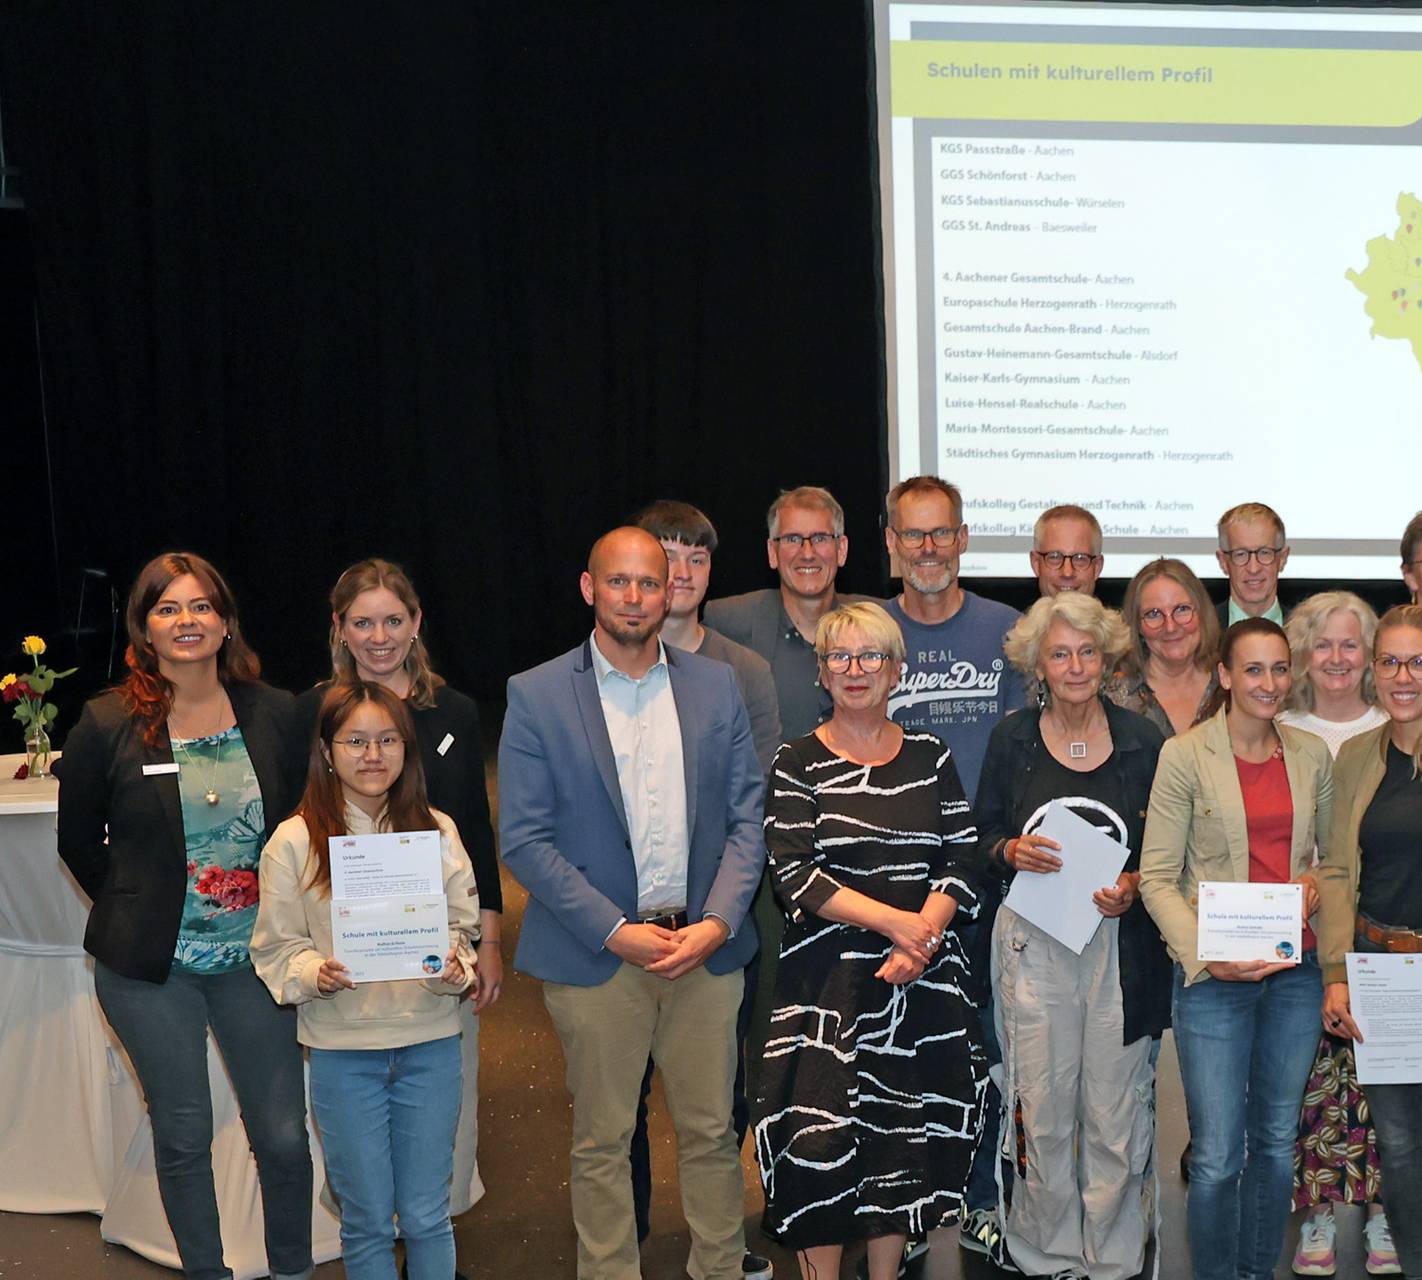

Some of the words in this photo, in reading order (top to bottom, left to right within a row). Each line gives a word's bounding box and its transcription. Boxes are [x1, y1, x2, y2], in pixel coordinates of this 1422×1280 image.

[927, 62, 1002, 80] Schulen
[1008, 63, 1040, 81] mit
[1046, 64, 1155, 82] kulturellem
[1161, 66, 1213, 84] Profil
[940, 144, 963, 155] KGS
[1034, 145, 1074, 157] Aachen
[940, 169, 965, 181] GGS
[966, 169, 1028, 182] Schönforst
[1036, 171, 1076, 183] Aachen
[941, 195, 964, 206] KGS
[1076, 196, 1125, 209] Würselen
[941, 220, 966, 232] GGS
[967, 220, 982, 232] St.
[985, 221, 1031, 233] Andreas
[942, 272, 953, 283] 4.
[955, 272, 1008, 284] Aachener
[1095, 274, 1134, 285] Aachen
[943, 297, 1018, 310] Europaschule
[1020, 297, 1097, 311] Herzogenrath
[1105, 299, 1177, 312] Herzogenrath
[943, 322, 1021, 334] Gesamtschule
[1024, 323, 1102, 335] Aachen-Brand
[1110, 324, 1150, 336] Aachen
[944, 348, 1132, 361] Gustav-Heinemann-Gesamtschule
[1140, 349, 1178, 362] Alsdorf
[944, 372, 1081, 385] Kaiser-Karls-Gymnasium
[1091, 374, 1130, 386] Aachen
[945, 398, 1079, 410] Luise-Hensel-Realschule
[1087, 399, 1126, 411] Aachen
[1130, 425, 1169, 436] Aachen
[946, 448, 1009, 460] Städtisches
[1011, 448, 1077, 461] Gymnasium
[1079, 449, 1154, 462] Herzogenrath
[1162, 450, 1234, 463] Herzogenrath
[1105, 500, 1146, 510] Technik
[1154, 501, 1194, 511] Aachen
[1150, 525, 1189, 535] Aachen
[918, 650, 957, 664] REAL
[342, 931, 366, 939] Schule
[379, 928, 419, 937] kulturellem
